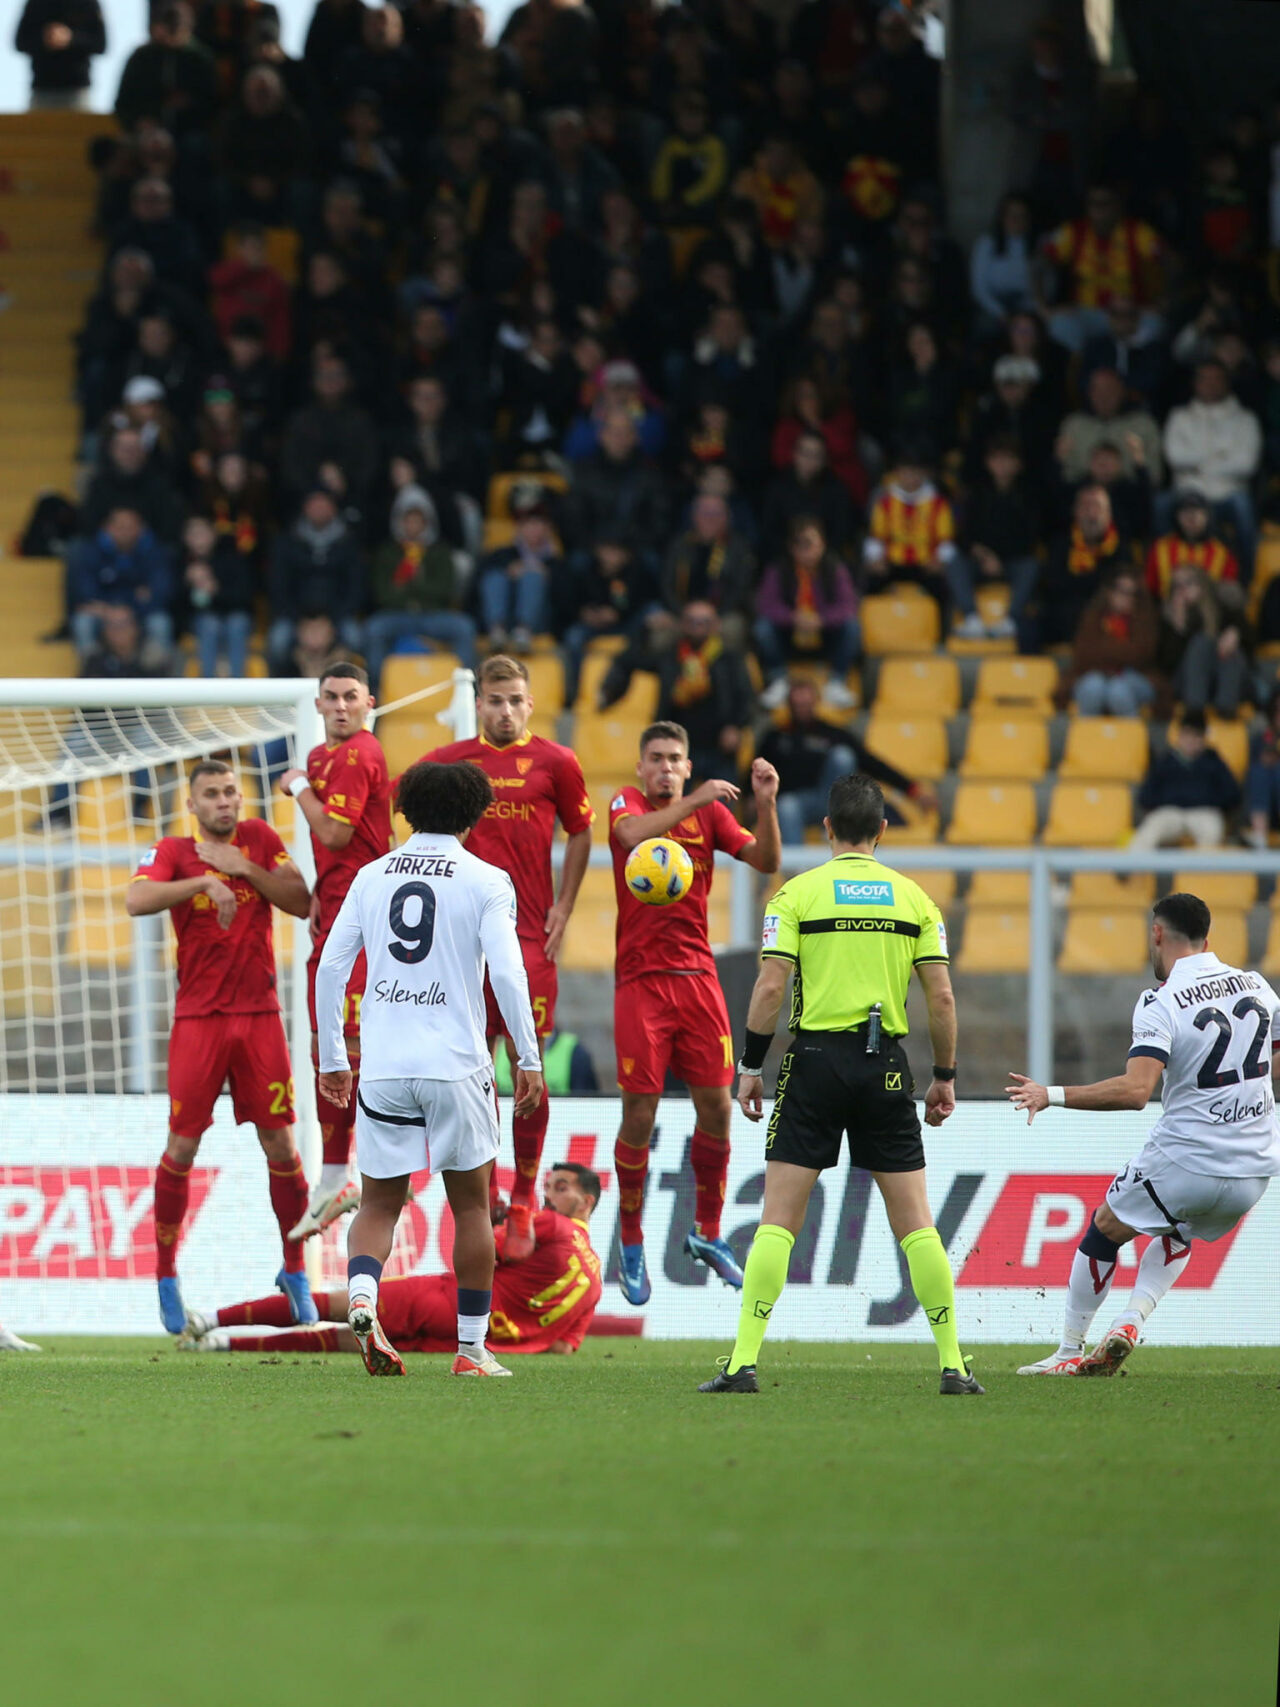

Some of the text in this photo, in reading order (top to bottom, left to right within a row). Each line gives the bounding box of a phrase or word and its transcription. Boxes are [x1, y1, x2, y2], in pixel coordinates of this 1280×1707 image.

[483, 800, 531, 821] EGHI
[384, 857, 457, 878] ZIRKZEE
[388, 880, 437, 965] 9
[835, 919, 896, 931] GIVOVA
[1173, 974, 1261, 1009] LYKOGIANNIS
[532, 996, 548, 1027] 5
[1192, 996, 1270, 1089] 22
